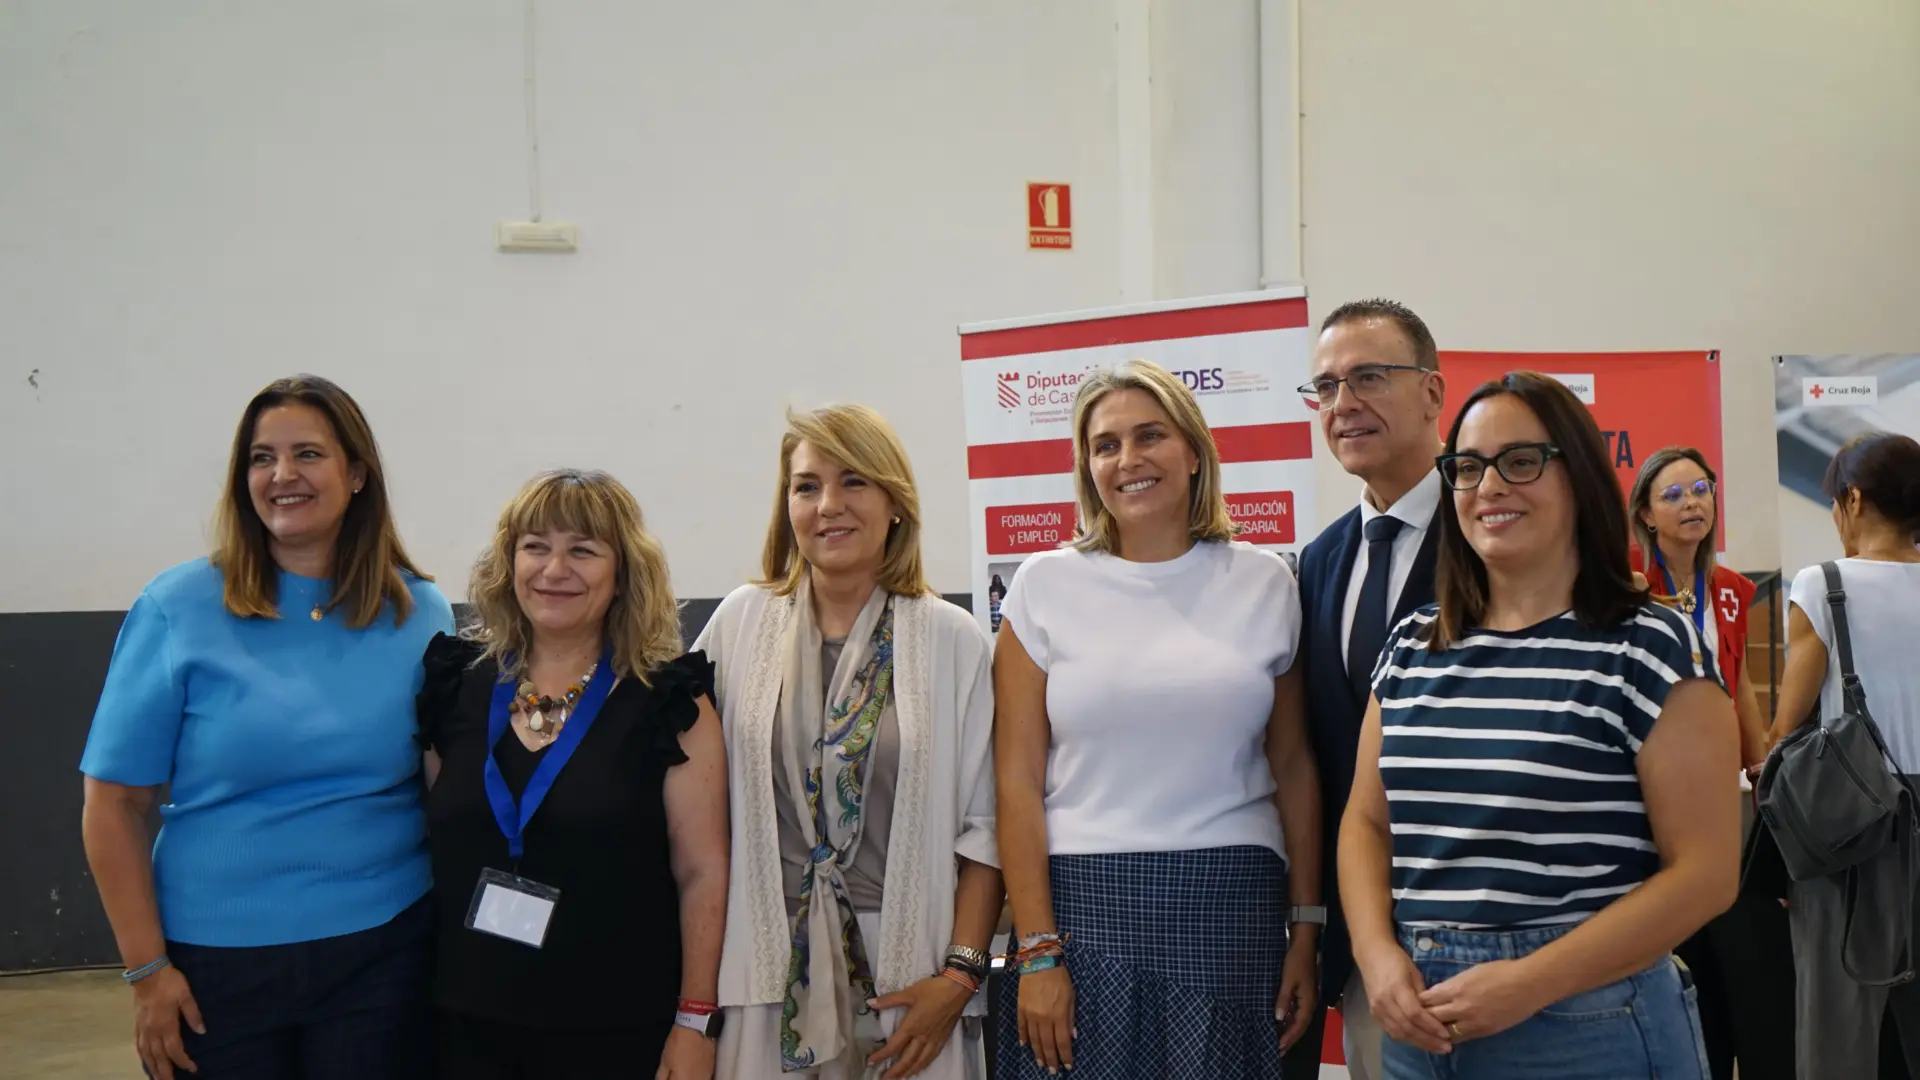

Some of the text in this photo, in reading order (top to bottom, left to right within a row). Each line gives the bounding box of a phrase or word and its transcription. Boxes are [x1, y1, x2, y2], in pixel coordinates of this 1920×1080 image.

[1027, 367, 1088, 391] Diputac
[1028, 389, 1077, 406] de Cas
[1828, 385, 1871, 395] Cruz Roja
[1601, 430, 1634, 469] TA
[1225, 499, 1286, 517] SOLIDACIÓN
[1001, 511, 1061, 528] FORMACIÓN
[1009, 529, 1059, 546] y EMPLEO
